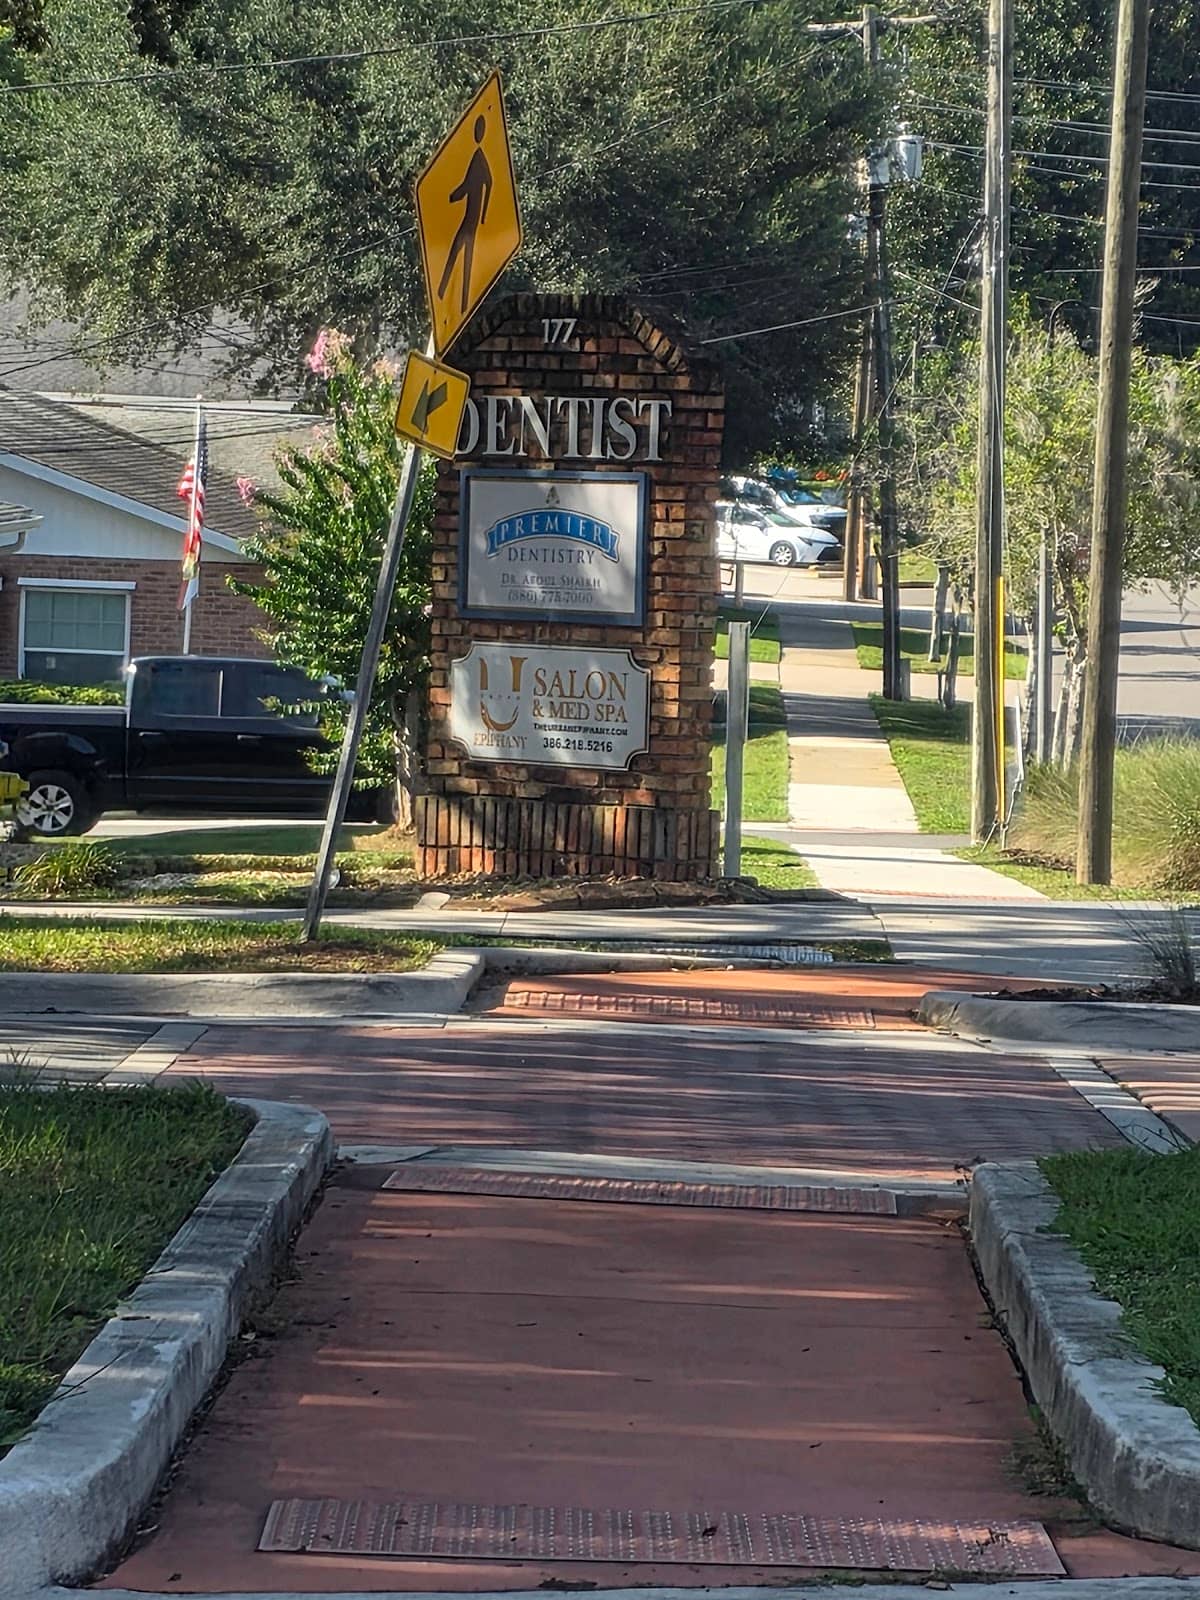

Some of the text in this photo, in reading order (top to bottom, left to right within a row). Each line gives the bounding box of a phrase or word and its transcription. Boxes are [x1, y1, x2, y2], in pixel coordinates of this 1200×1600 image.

[541, 318, 578, 344] 177
[501, 514, 603, 543] PREMIER
[507, 547, 595, 564] DENTISTRY
[533, 667, 630, 702] SALON
[532, 700, 628, 723] & MED SPA
[543, 737, 613, 753] 386.218.5216
